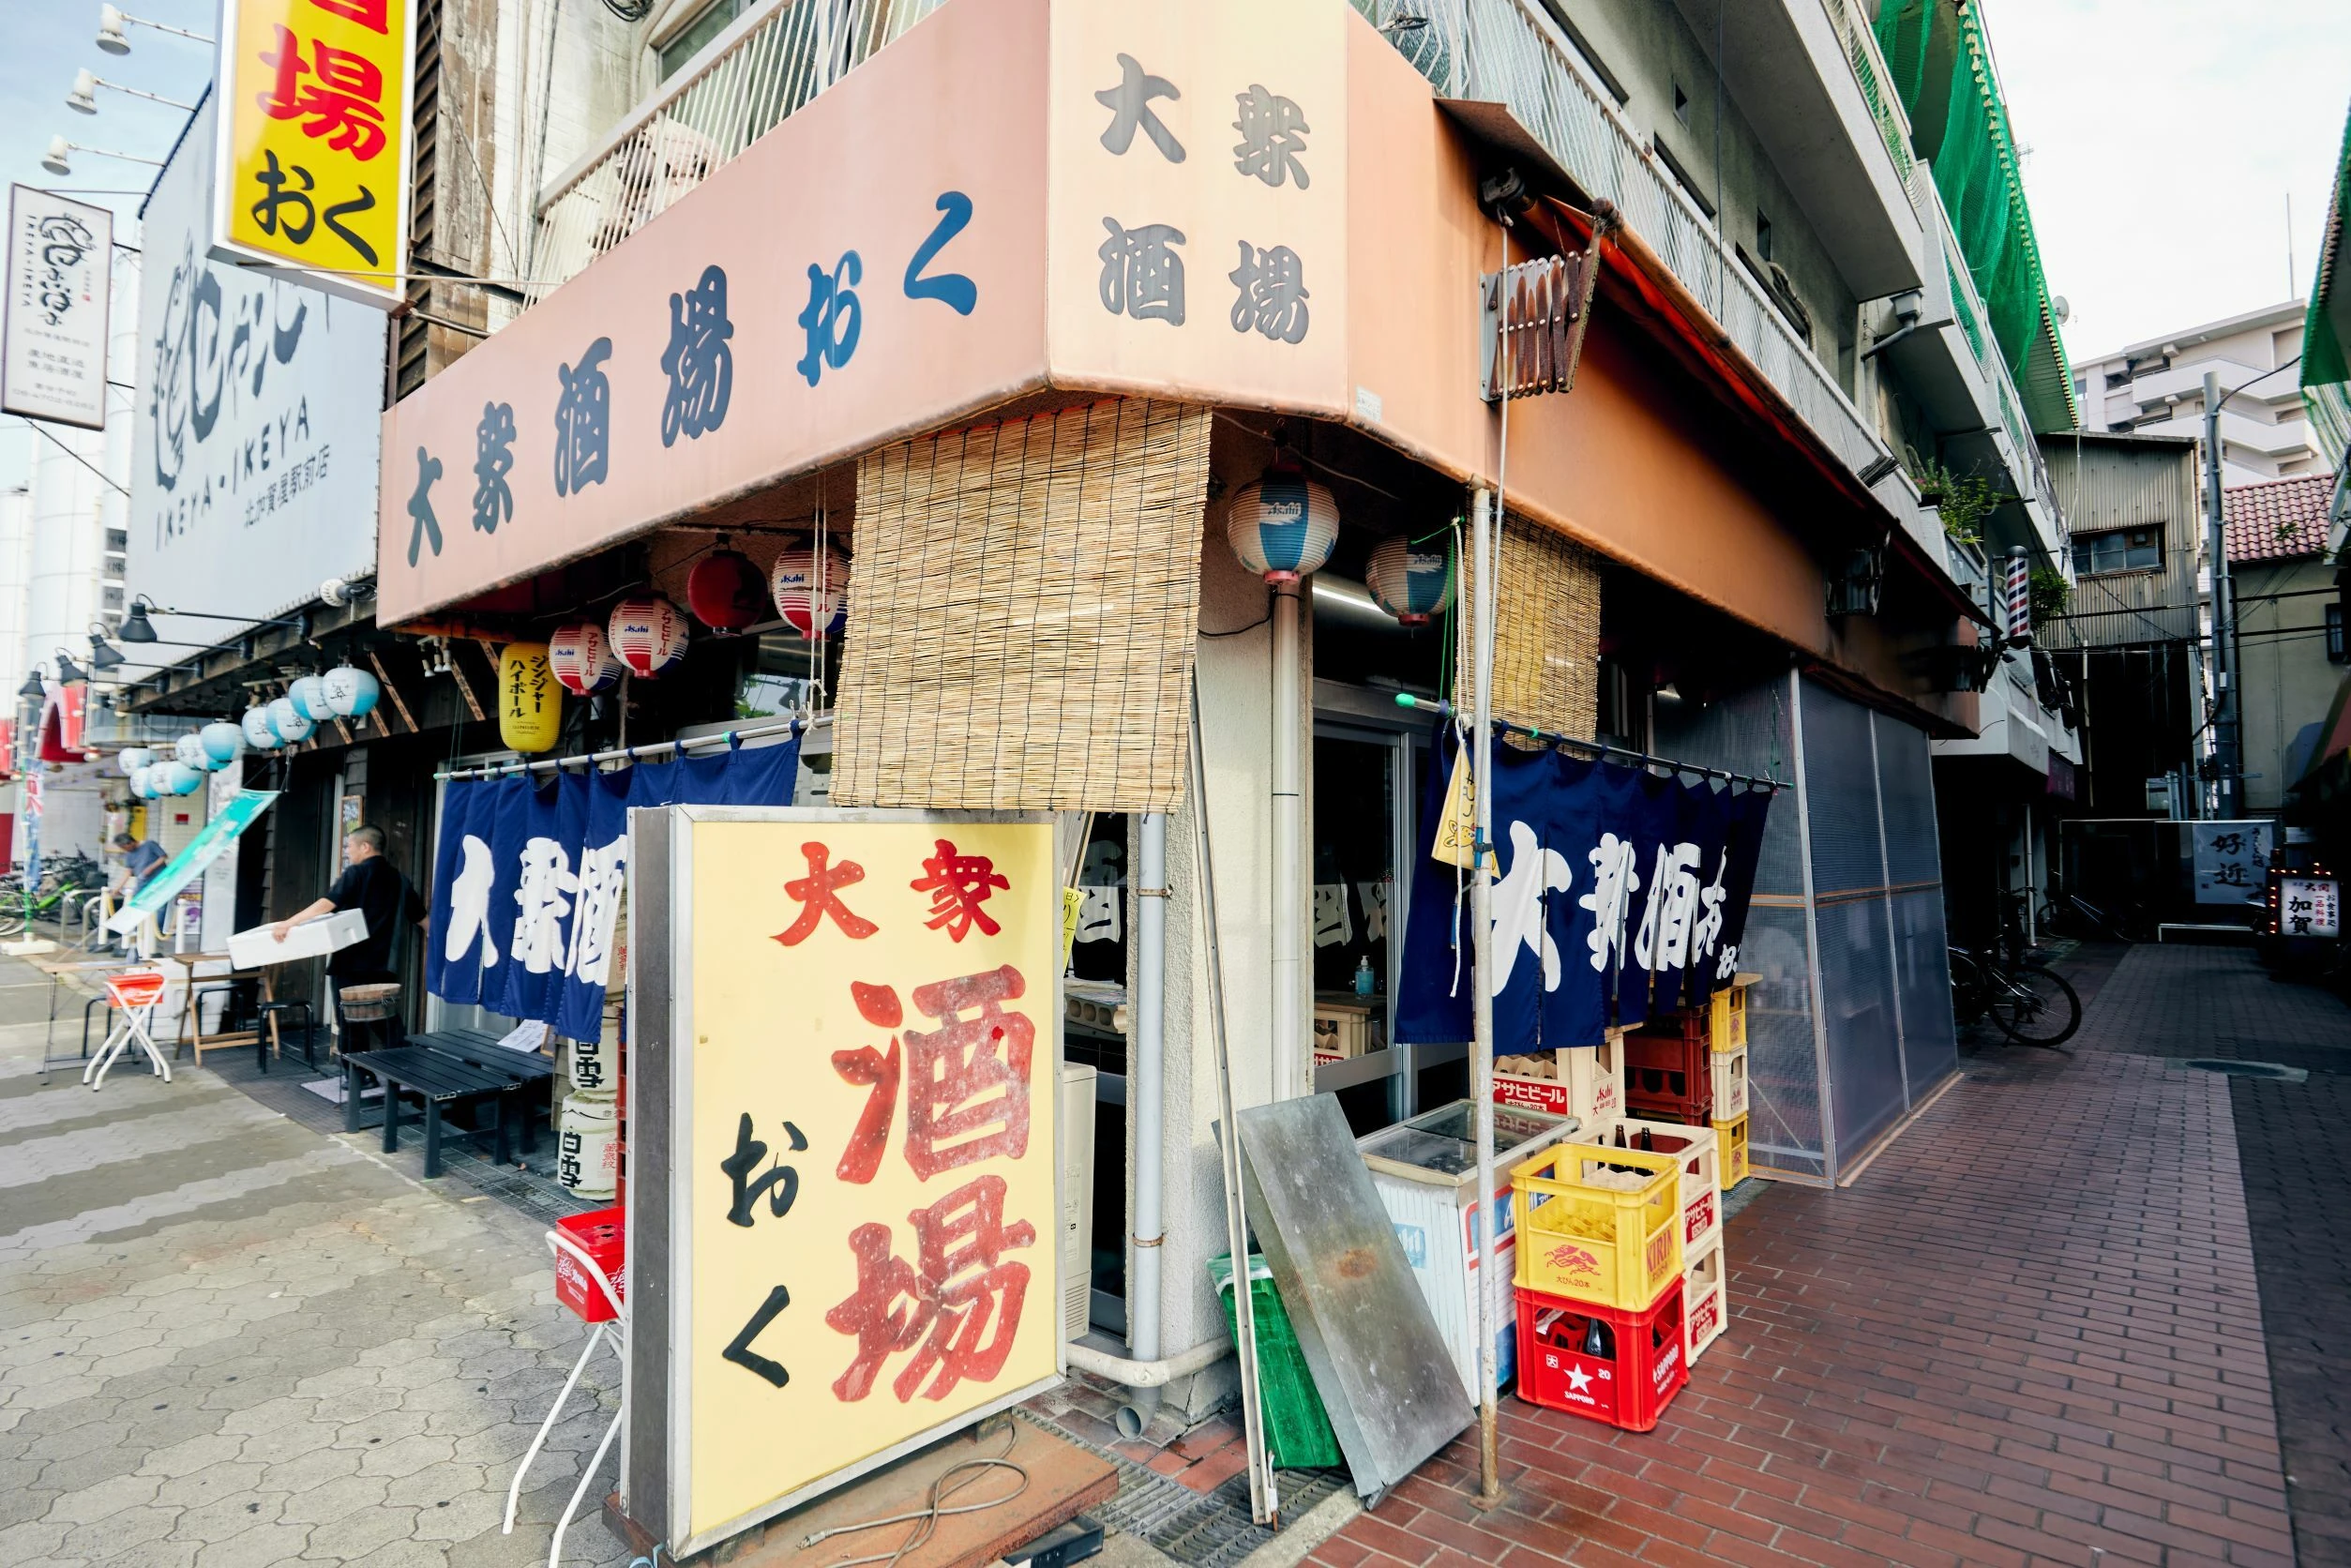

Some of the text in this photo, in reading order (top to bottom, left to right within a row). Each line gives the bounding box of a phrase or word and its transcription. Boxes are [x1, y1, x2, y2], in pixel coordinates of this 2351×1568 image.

[256, 0, 389, 161] 場
[1094, 53, 1310, 190] 大衆
[252, 148, 379, 267] おく
[1098, 217, 1310, 345] 酒場
[1268, 503, 1302, 517] Asahi
[780, 574, 805, 583] Asahi
[555, 648, 575, 656] Asahi
[625, 625, 649, 633] Asahi
[656, 608, 671, 656] アサヒビール
[584, 632, 598, 676] アサヒビール
[508, 659, 526, 718] ハイボール
[529, 655, 548, 713] ジンジャー
[771, 838, 1011, 947] 大衆
[2288, 896, 2313, 935] 加賀
[1493, 1082, 1565, 1104] アサヒビール
[824, 964, 1036, 1404] 酒場
[720, 1112, 808, 1389] おく
[1647, 1229, 1673, 1272] KIRIN
[1598, 1368, 1611, 1380] 20
[1564, 1391, 1595, 1405] SAPPORO
